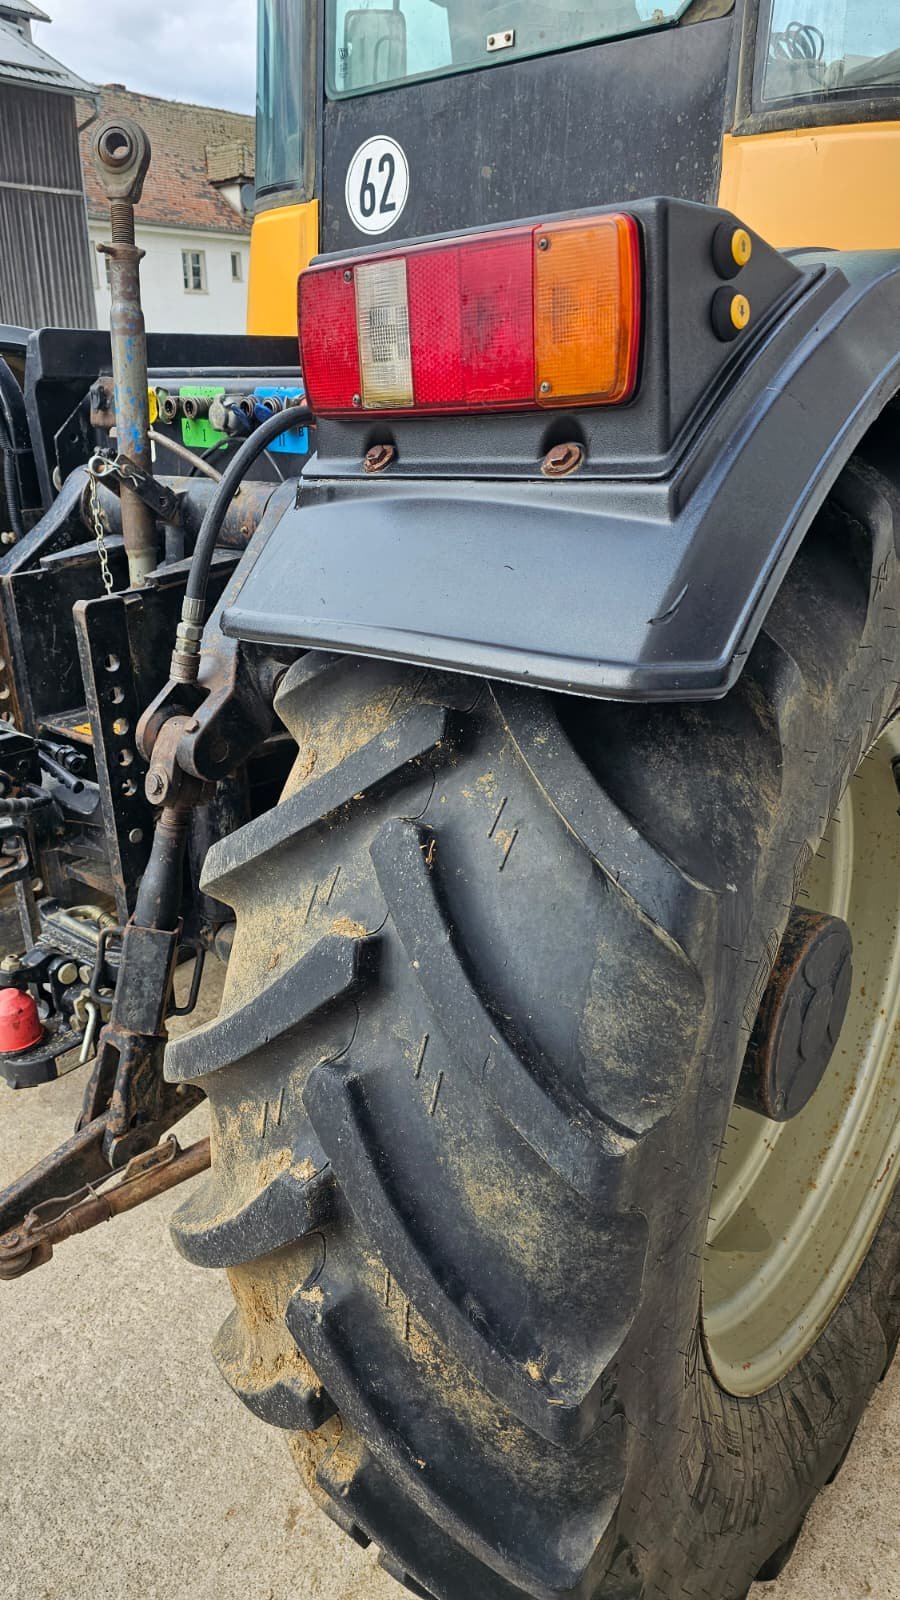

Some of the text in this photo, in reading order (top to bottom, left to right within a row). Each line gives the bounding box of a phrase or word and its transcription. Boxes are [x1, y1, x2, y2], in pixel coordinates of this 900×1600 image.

[359, 152, 396, 218] 62
[186, 421, 191, 430] A
[298, 426, 304, 437] B
